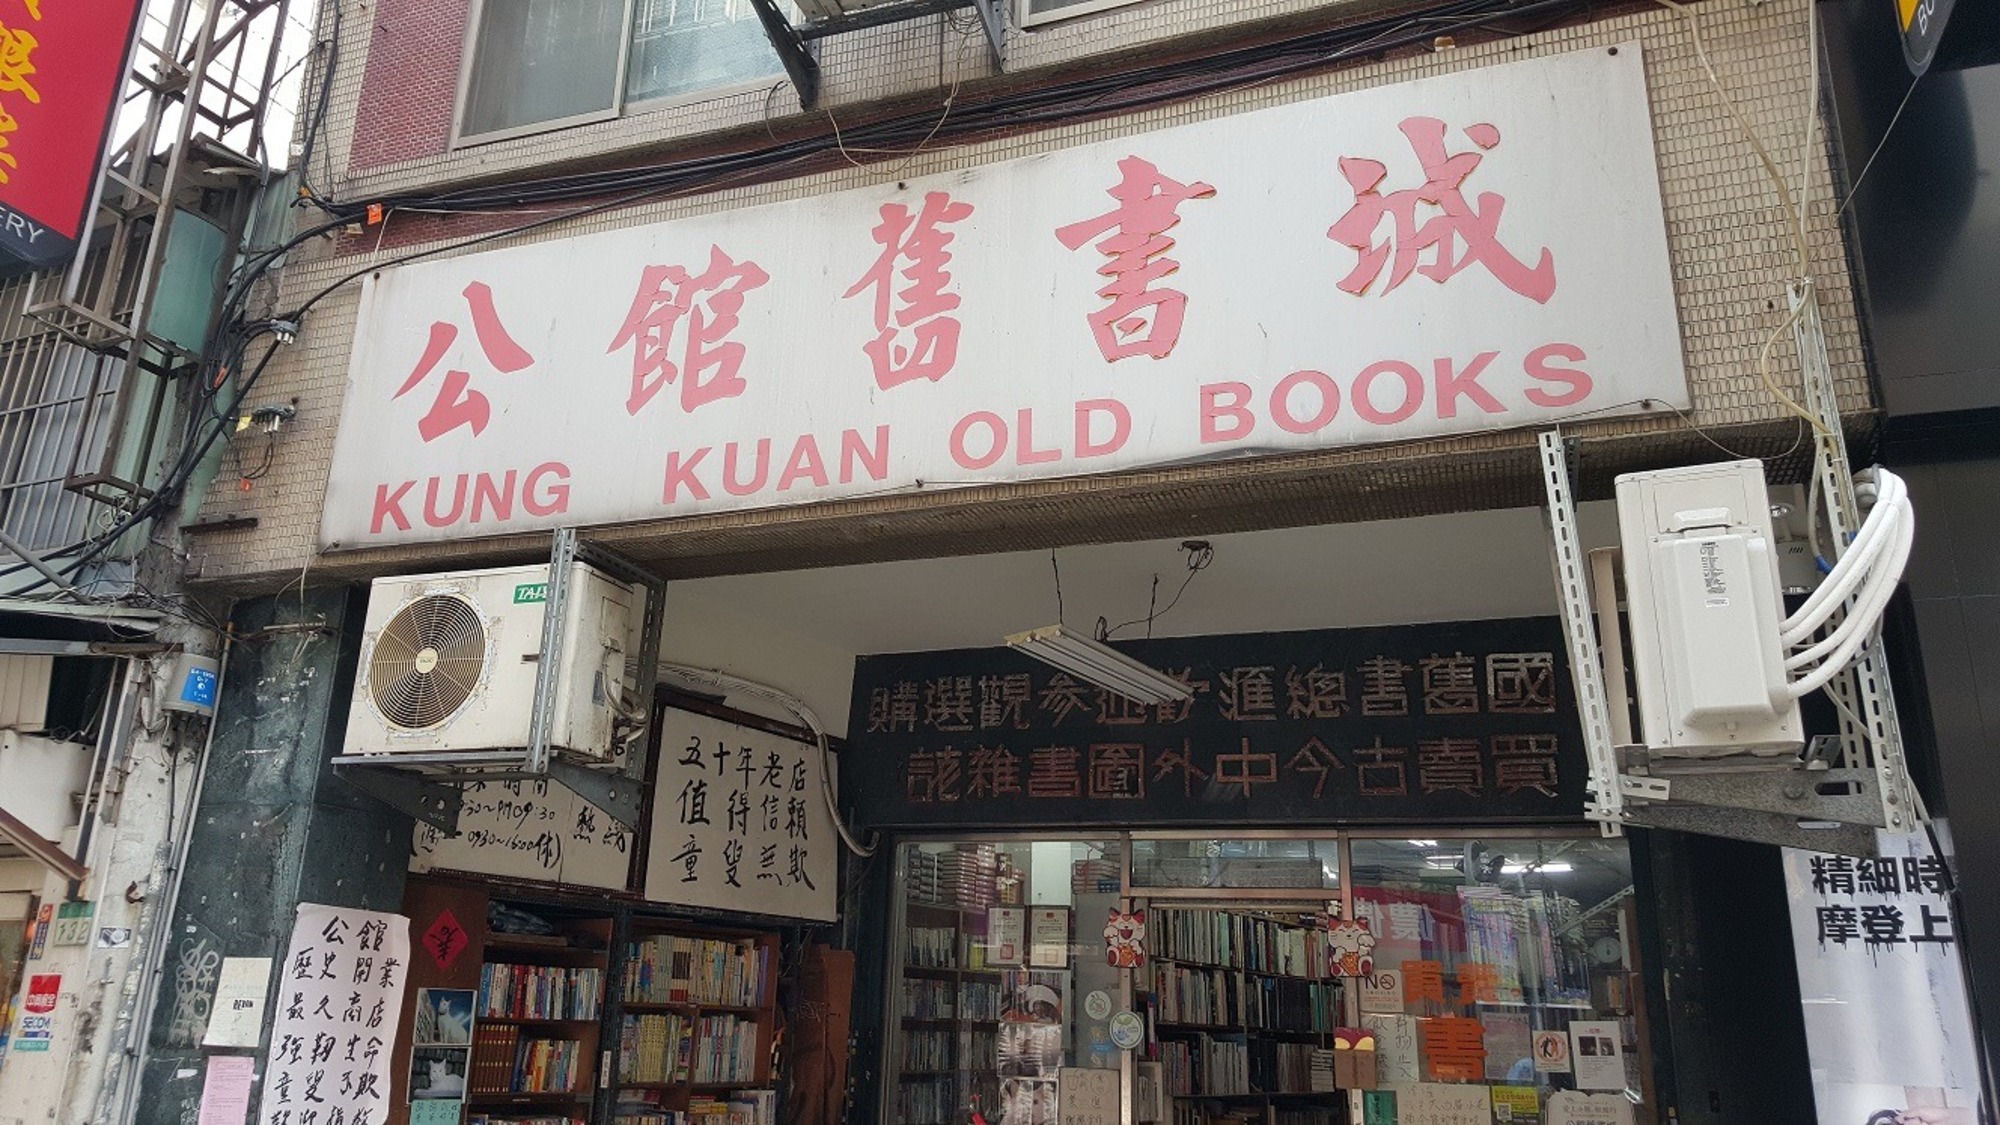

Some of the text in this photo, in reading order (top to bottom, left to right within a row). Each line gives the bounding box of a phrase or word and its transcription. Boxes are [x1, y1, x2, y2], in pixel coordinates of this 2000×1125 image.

[371, 343, 1593, 533] KUNG KUAN OLD BOOKS
[678, 736, 807, 794] 五十年老店
[670, 834, 815, 890] 童叟無欺
[56, 921, 91, 942] 132
[322, 915, 388, 951] 公館
[1816, 904, 1955, 946] 摩登上
